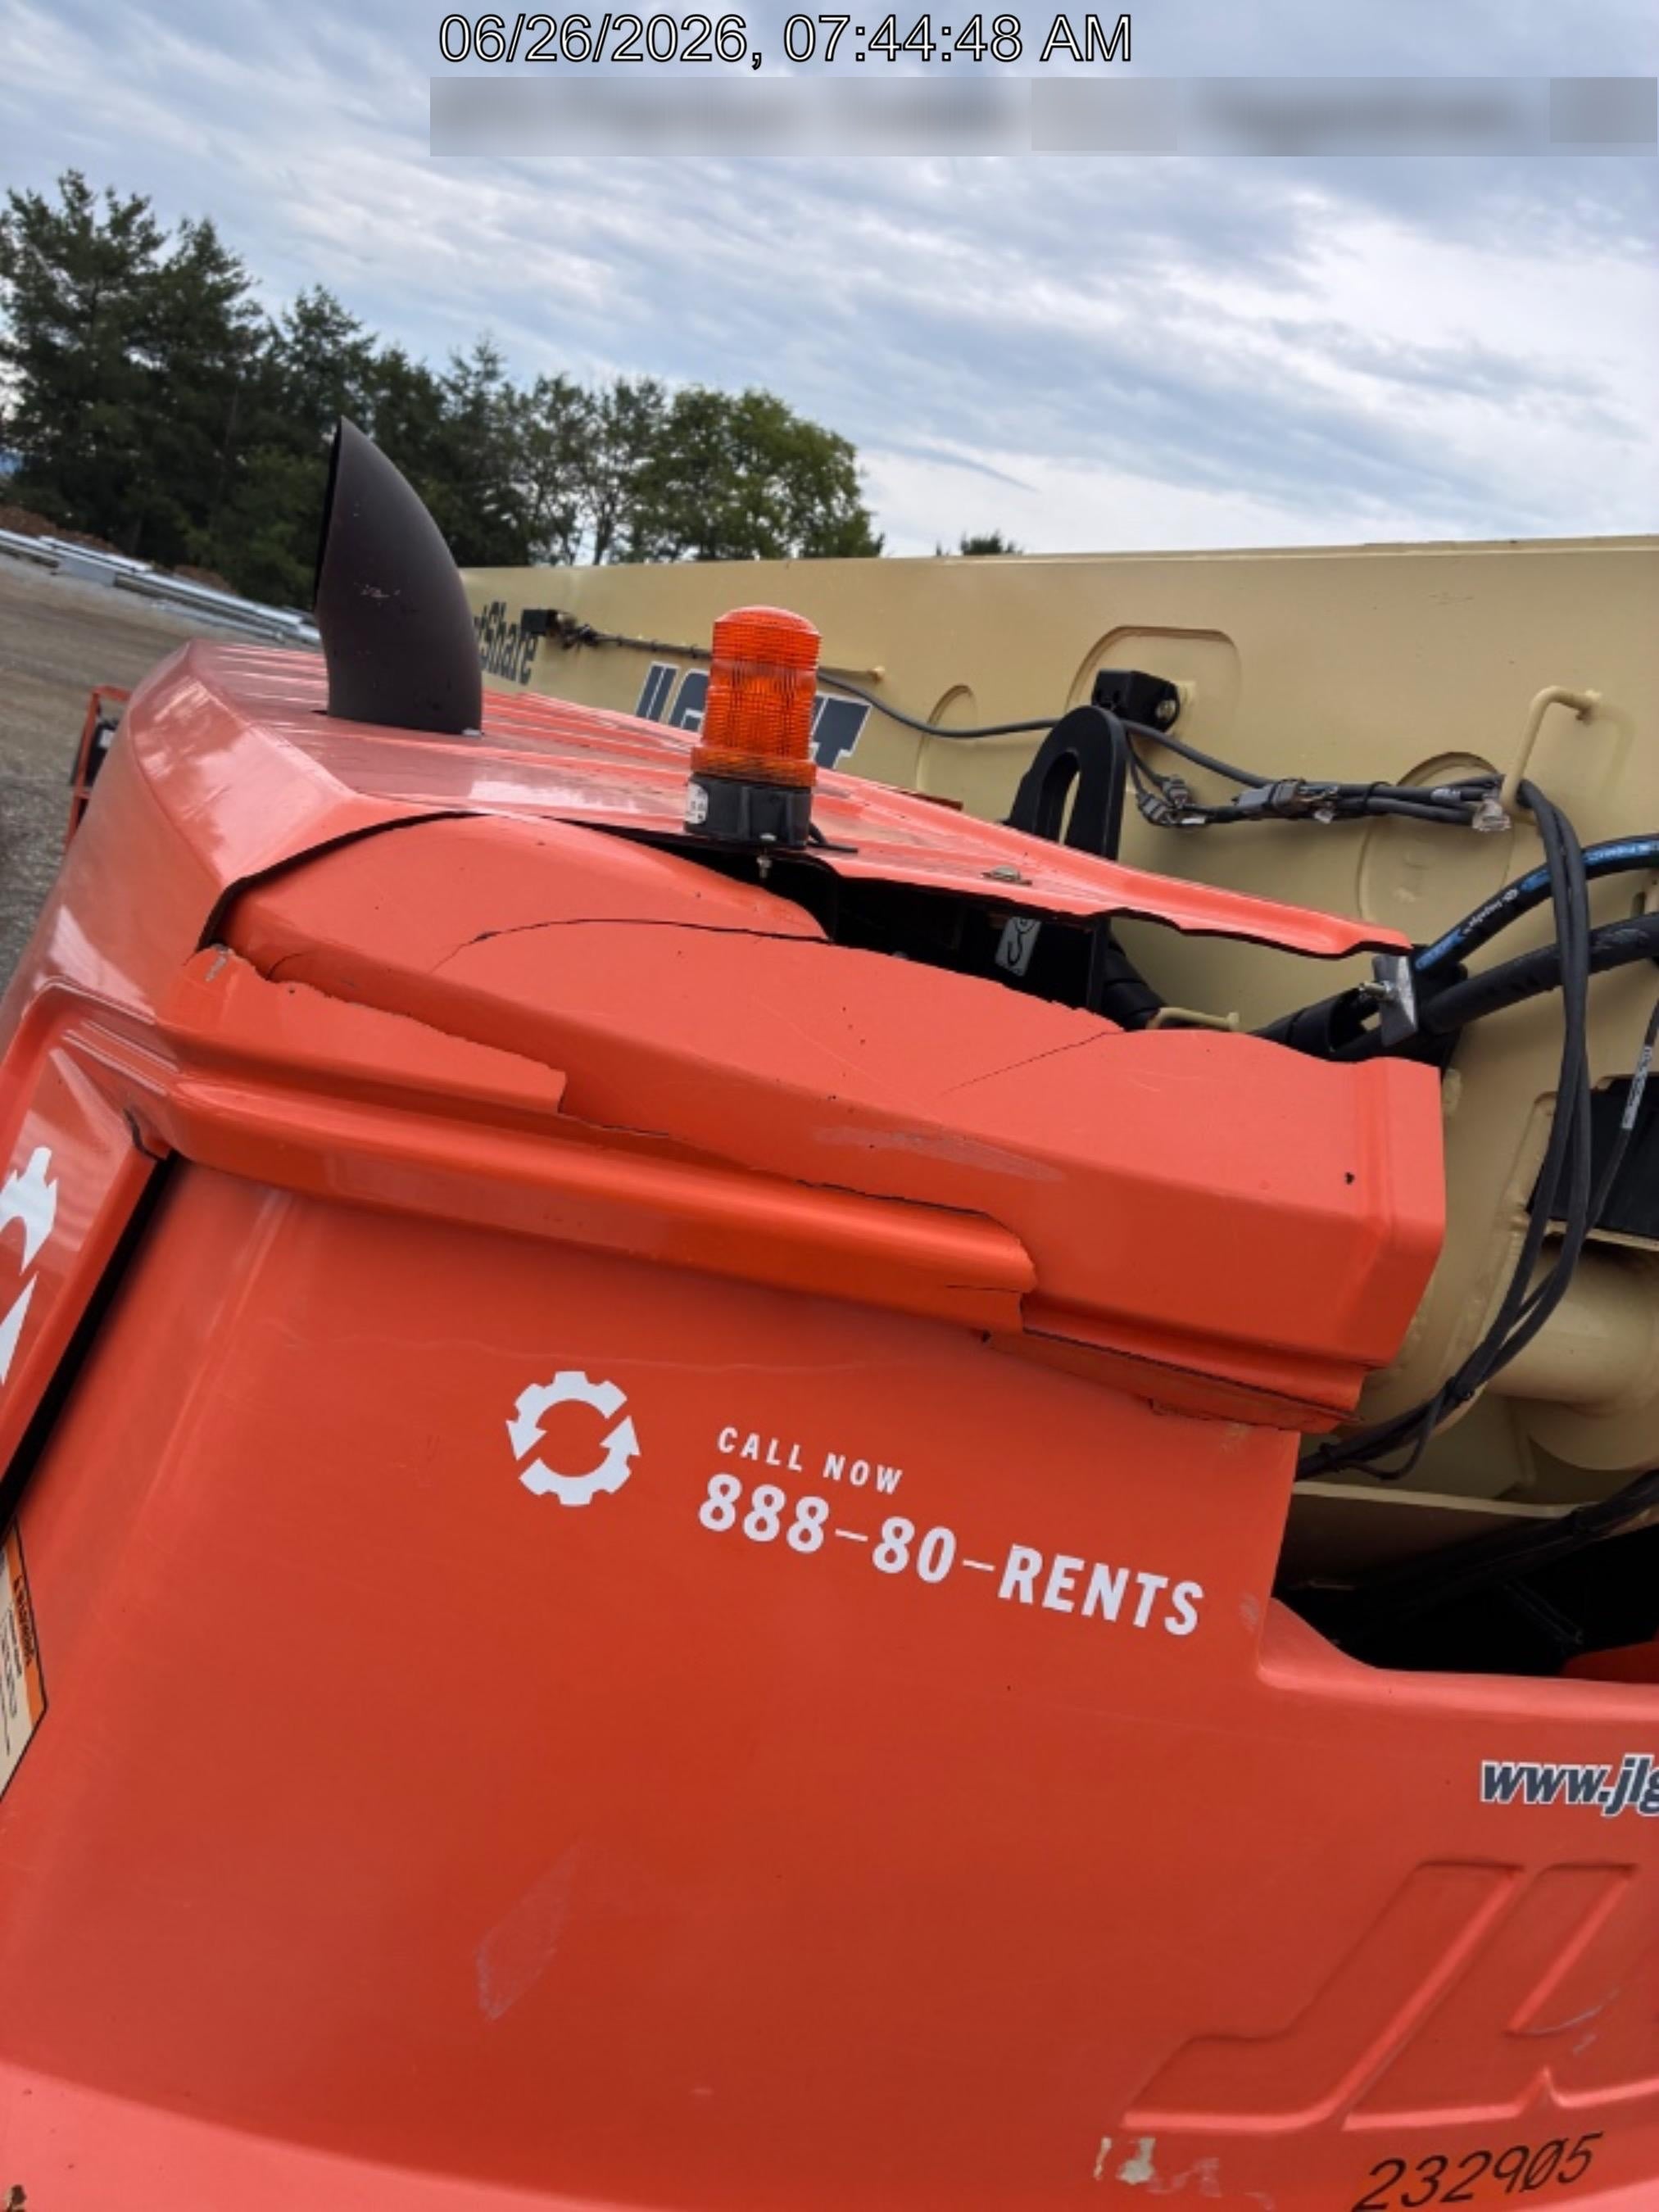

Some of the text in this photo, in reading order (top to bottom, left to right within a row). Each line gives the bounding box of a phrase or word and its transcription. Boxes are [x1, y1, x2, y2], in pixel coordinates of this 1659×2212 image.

[717, 1426, 904, 1495] CALL NOW
[697, 1471, 1205, 1637] 888-80-RENTS
